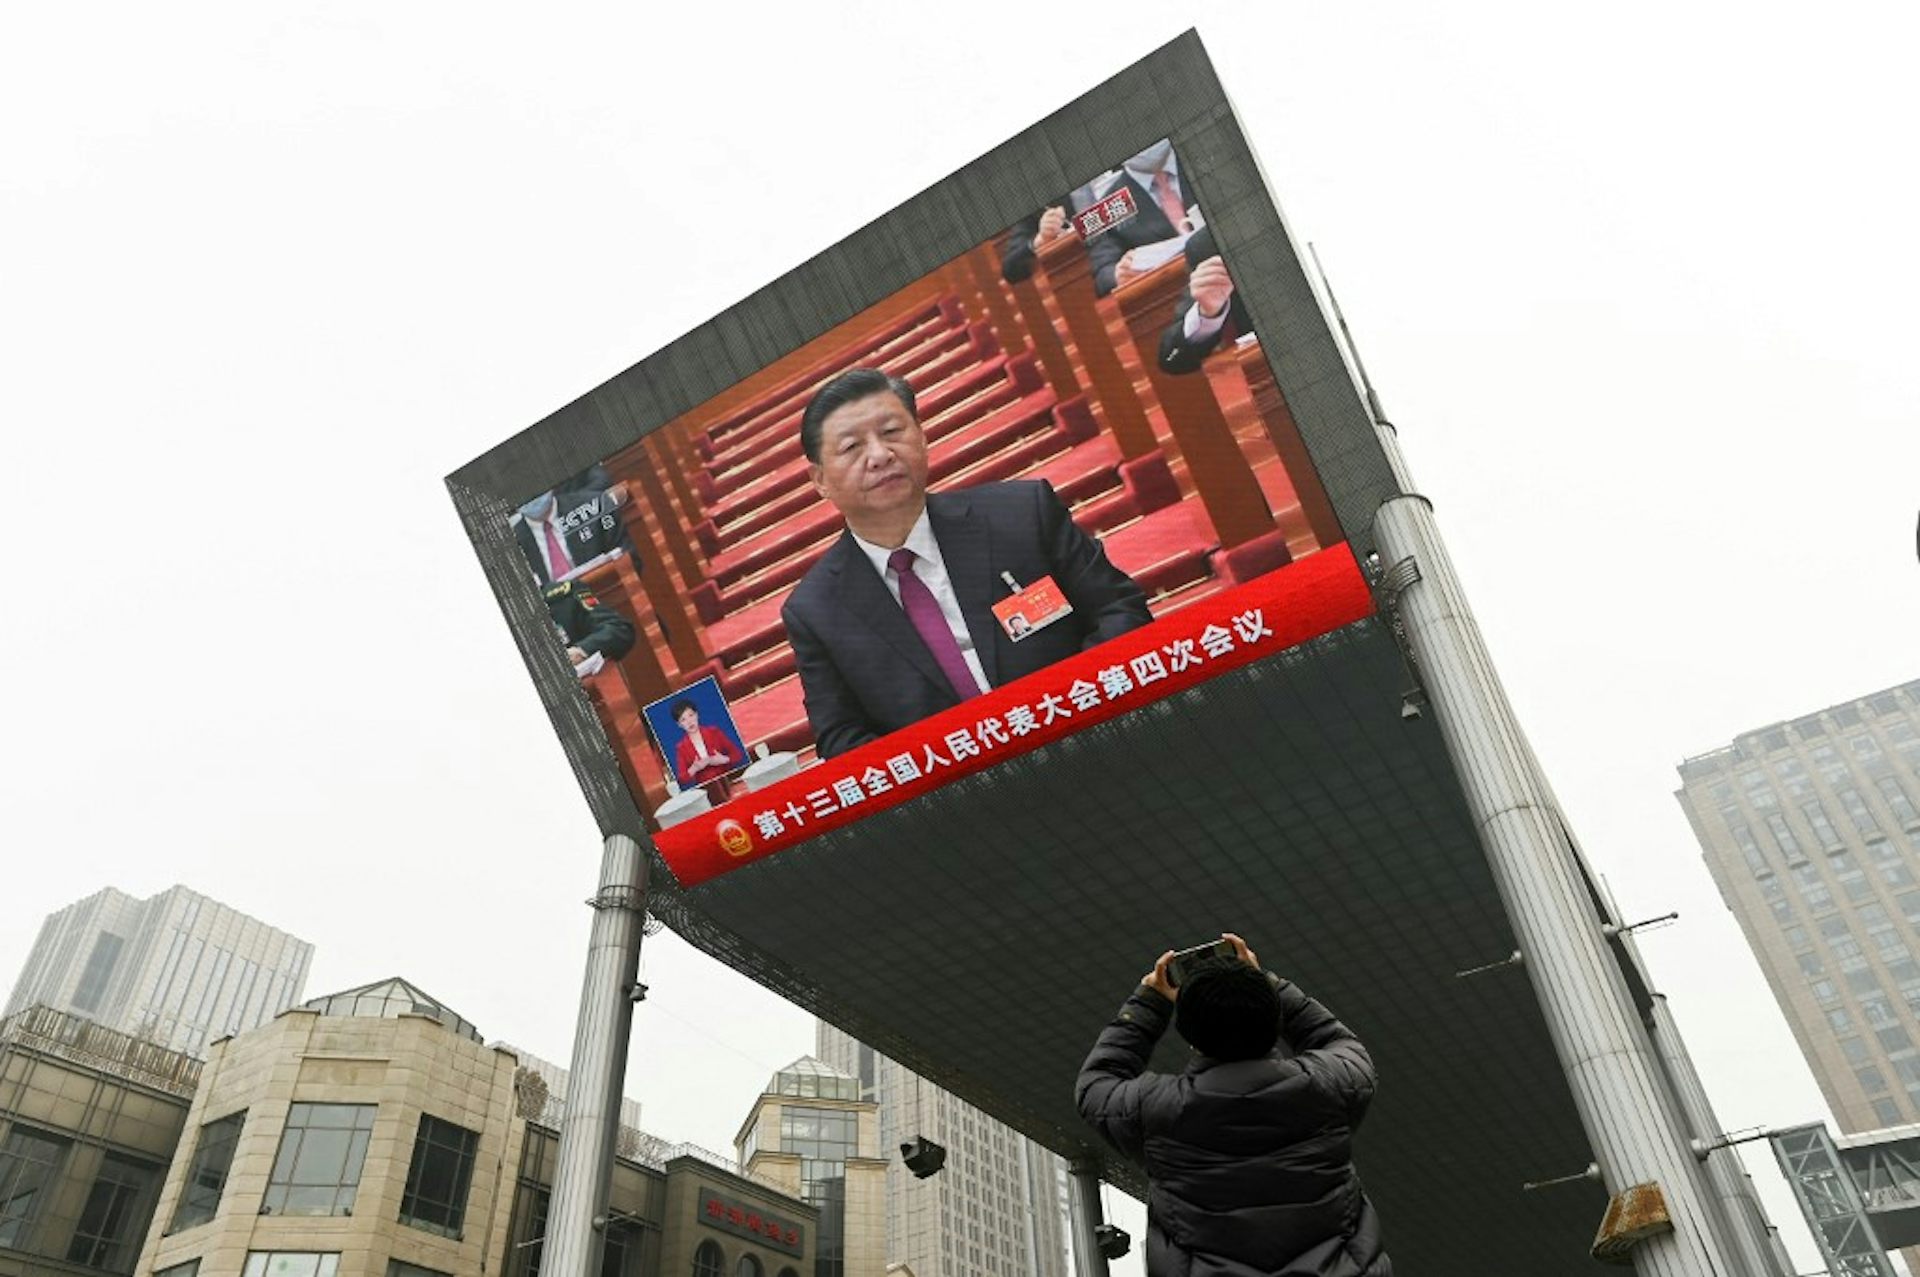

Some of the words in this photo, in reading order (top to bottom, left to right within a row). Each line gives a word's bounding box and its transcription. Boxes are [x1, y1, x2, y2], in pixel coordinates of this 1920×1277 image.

[1080, 195, 1128, 236] 直播
[557, 497, 599, 531] CCTV
[752, 608, 1273, 841] 第十三届全国人民代表大会第四次会议
